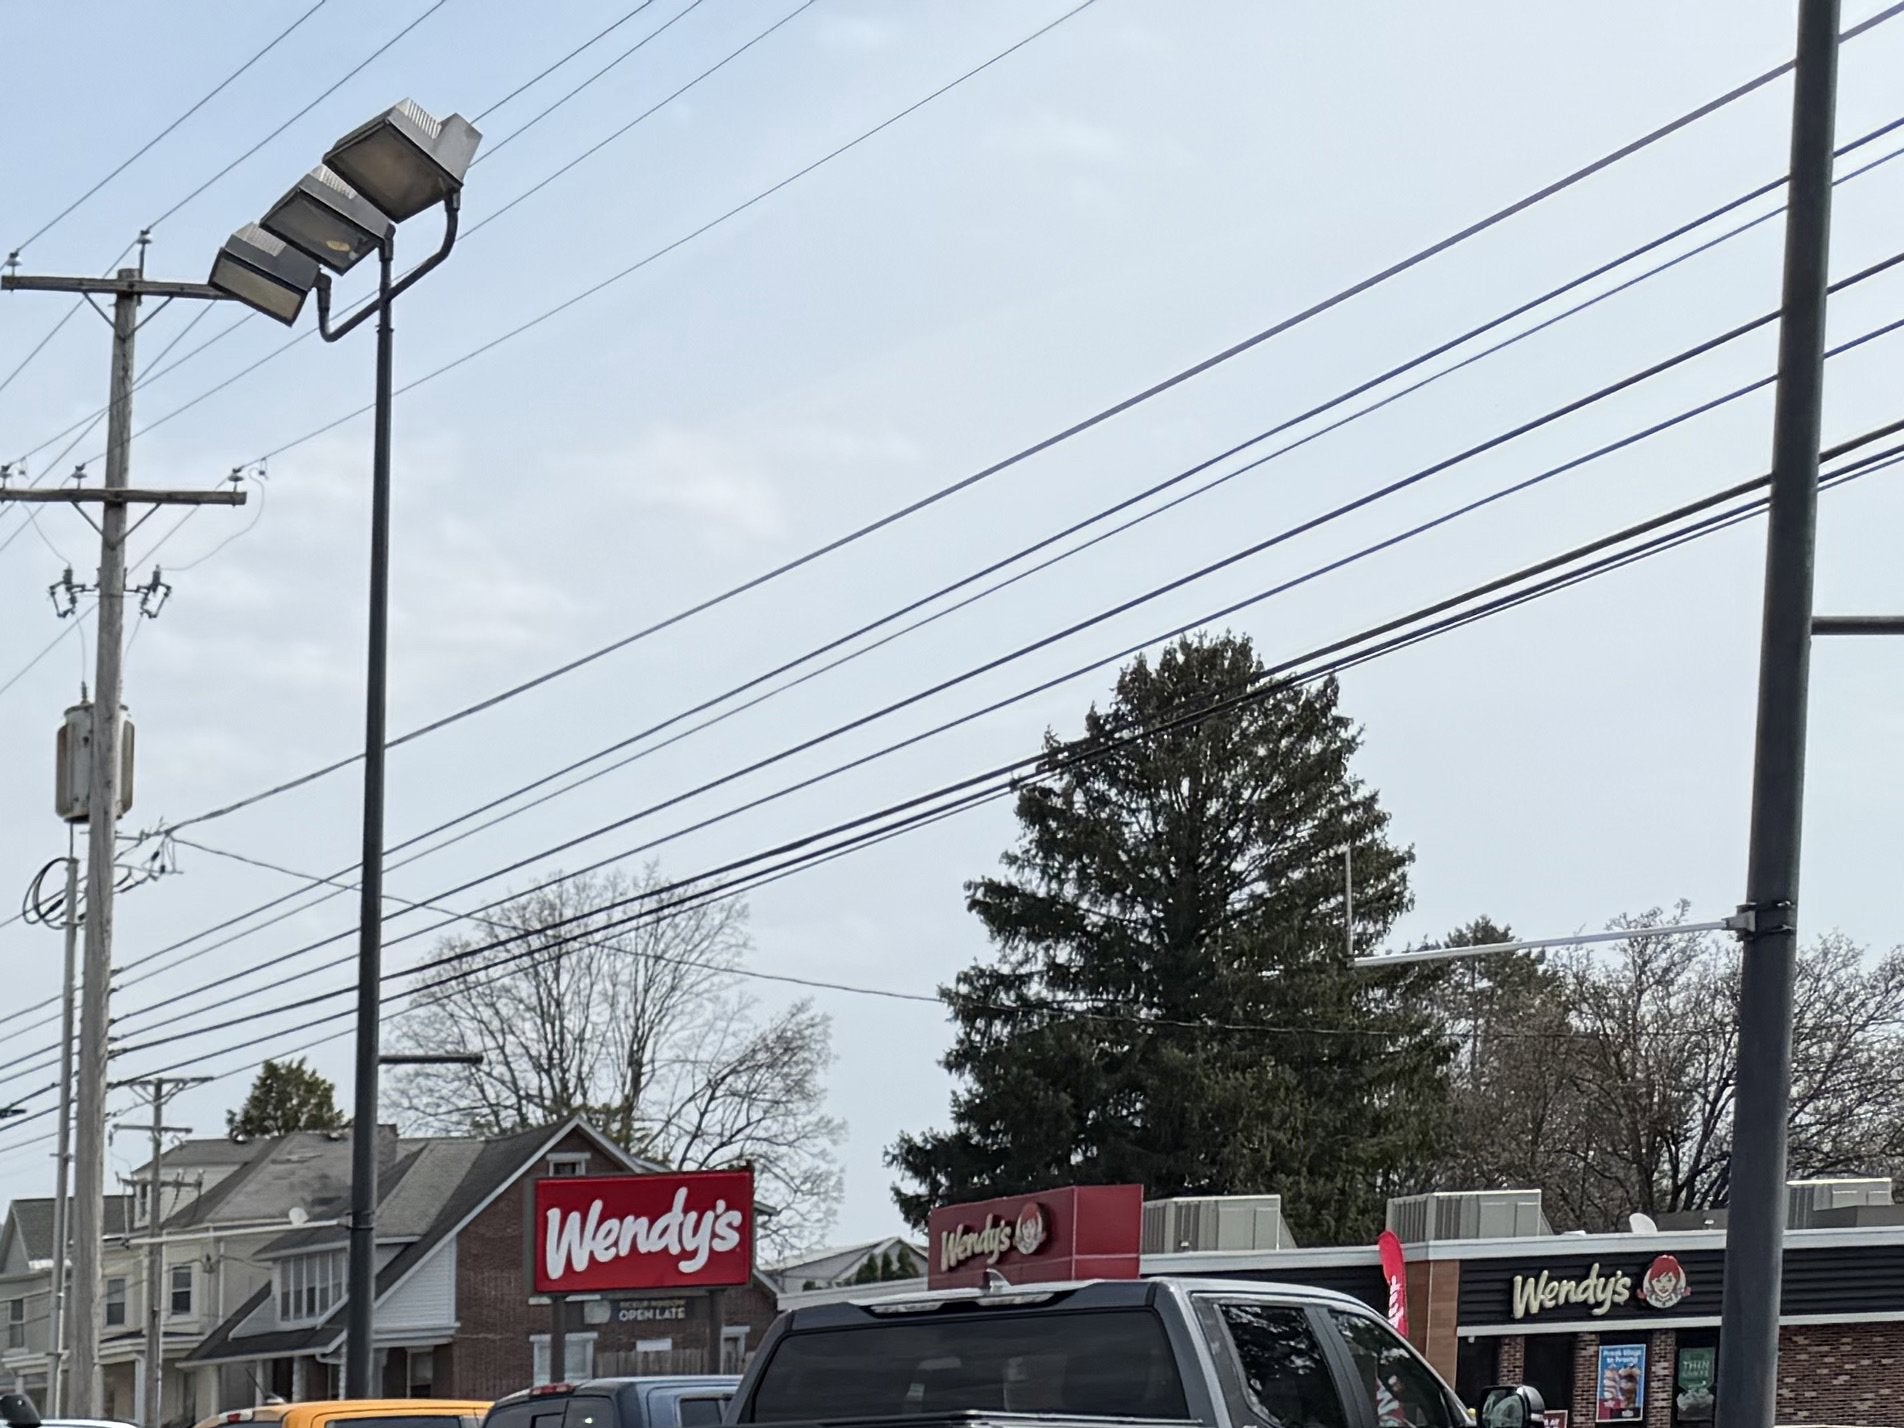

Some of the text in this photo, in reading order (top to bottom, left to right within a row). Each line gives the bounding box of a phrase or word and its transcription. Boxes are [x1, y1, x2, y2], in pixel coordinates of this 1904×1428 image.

[546, 1186, 743, 1280] Wendy's
[940, 1212, 1012, 1273] Wendy's
[618, 1307, 686, 1322] OPEN LATE
[1512, 1262, 1632, 1320] Wendy's
